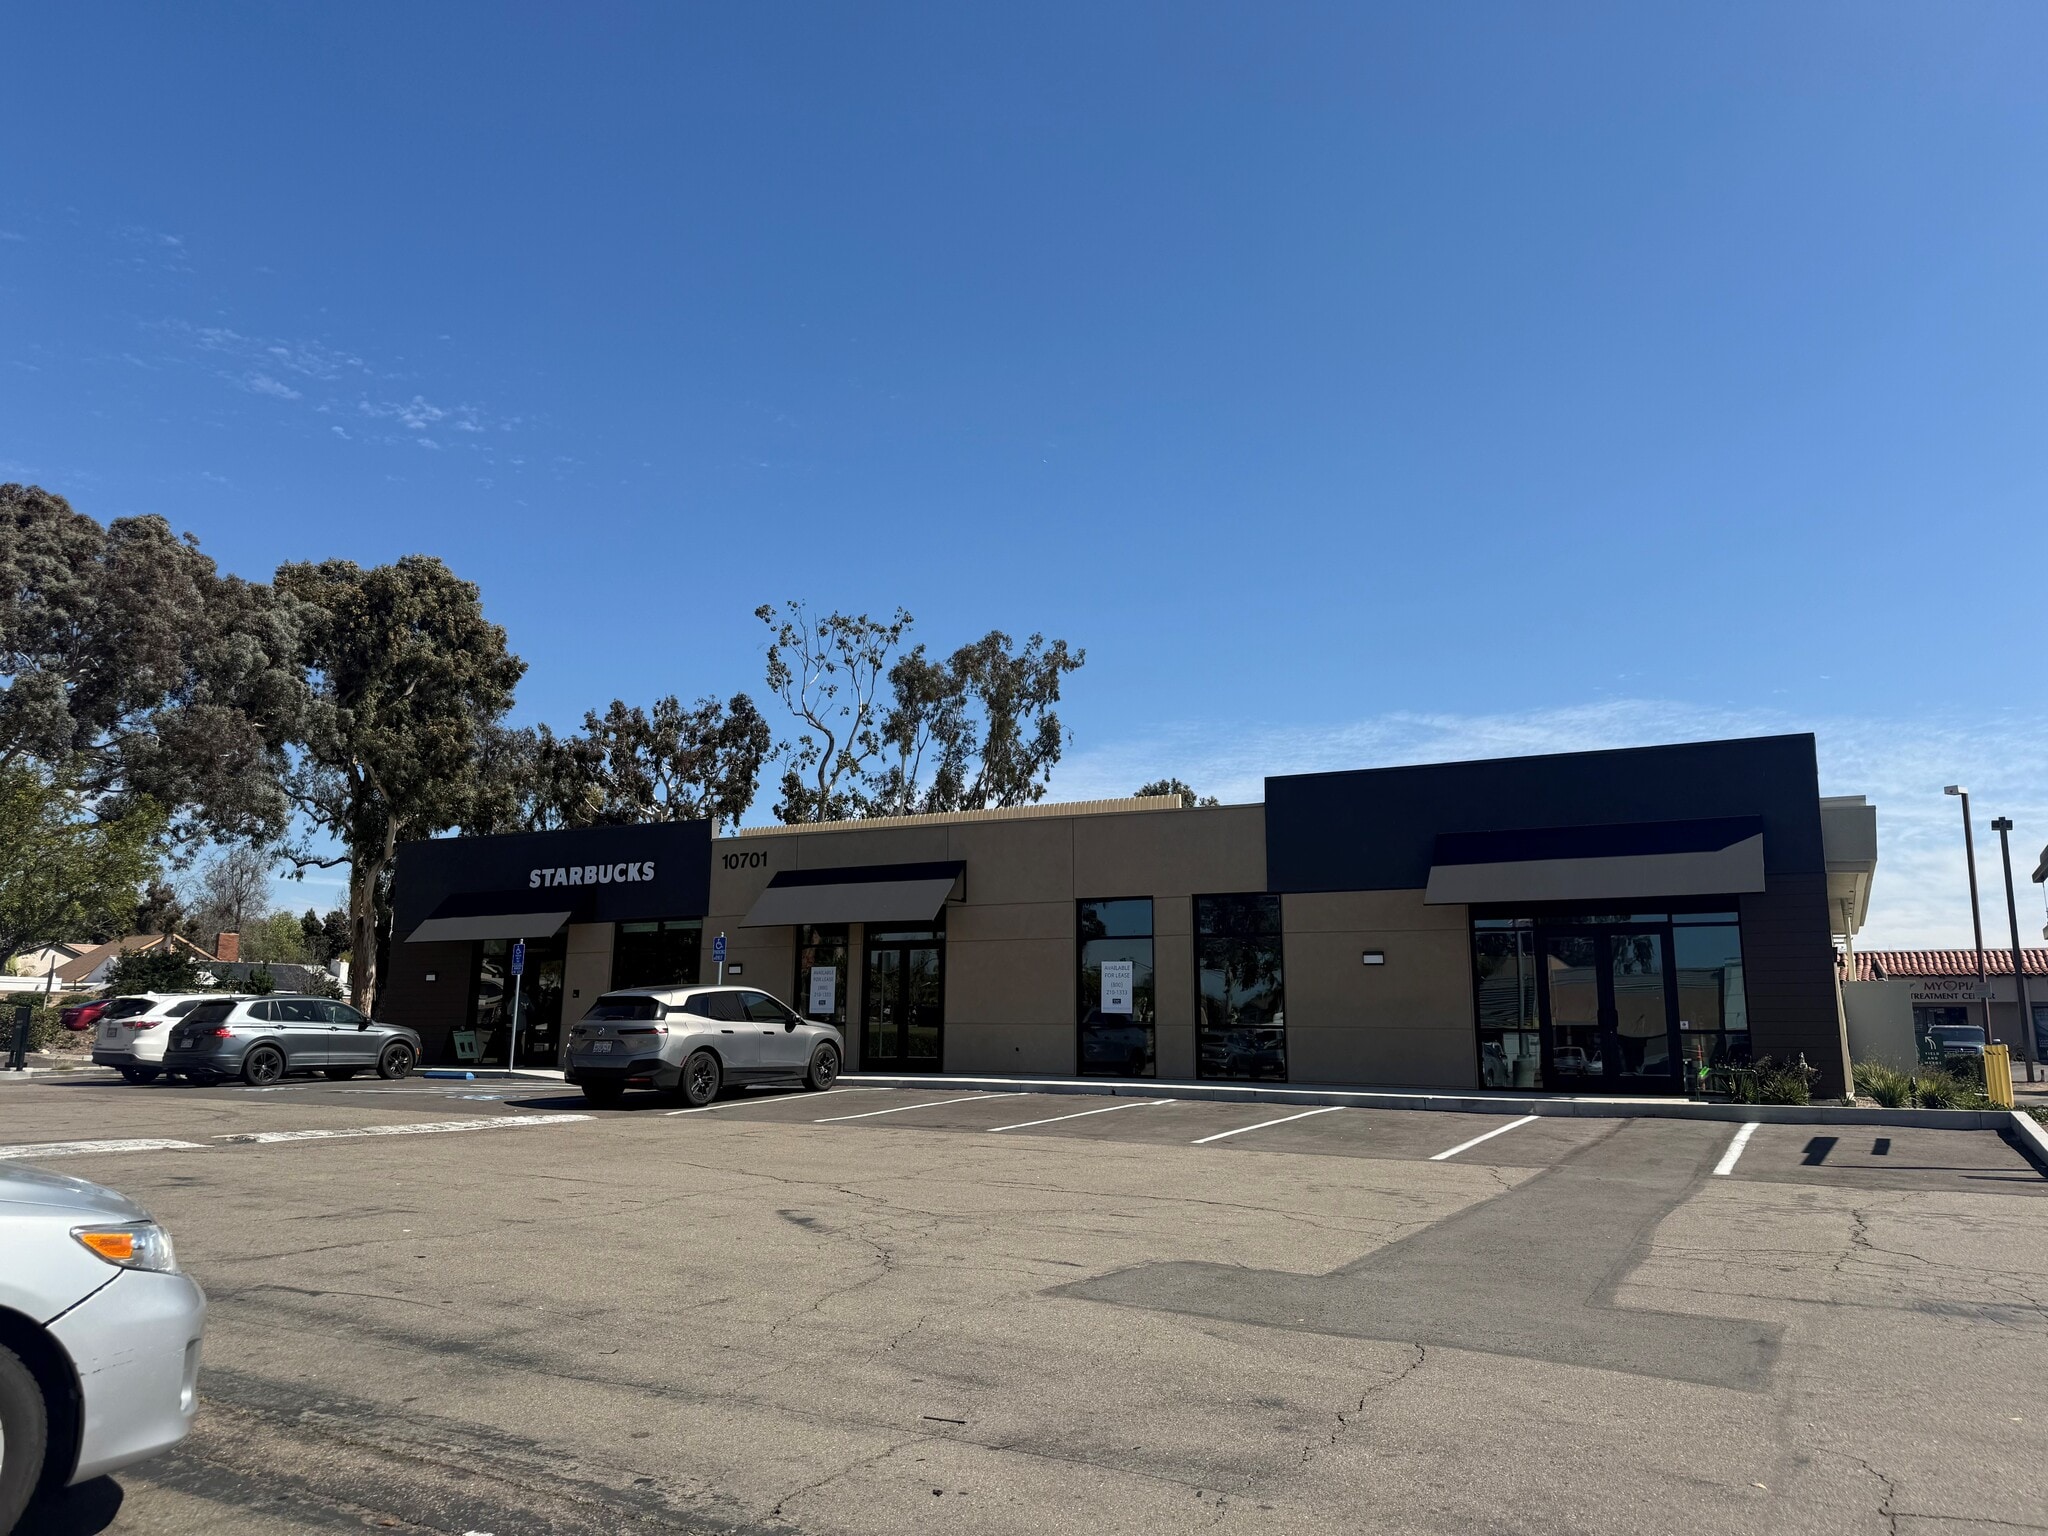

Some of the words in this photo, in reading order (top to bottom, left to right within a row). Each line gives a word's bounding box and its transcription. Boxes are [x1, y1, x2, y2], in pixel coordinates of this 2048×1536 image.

[722, 851, 768, 870] 10701
[529, 861, 655, 888] STARBUCKS
[1911, 992, 1959, 1000] TREATMENT
